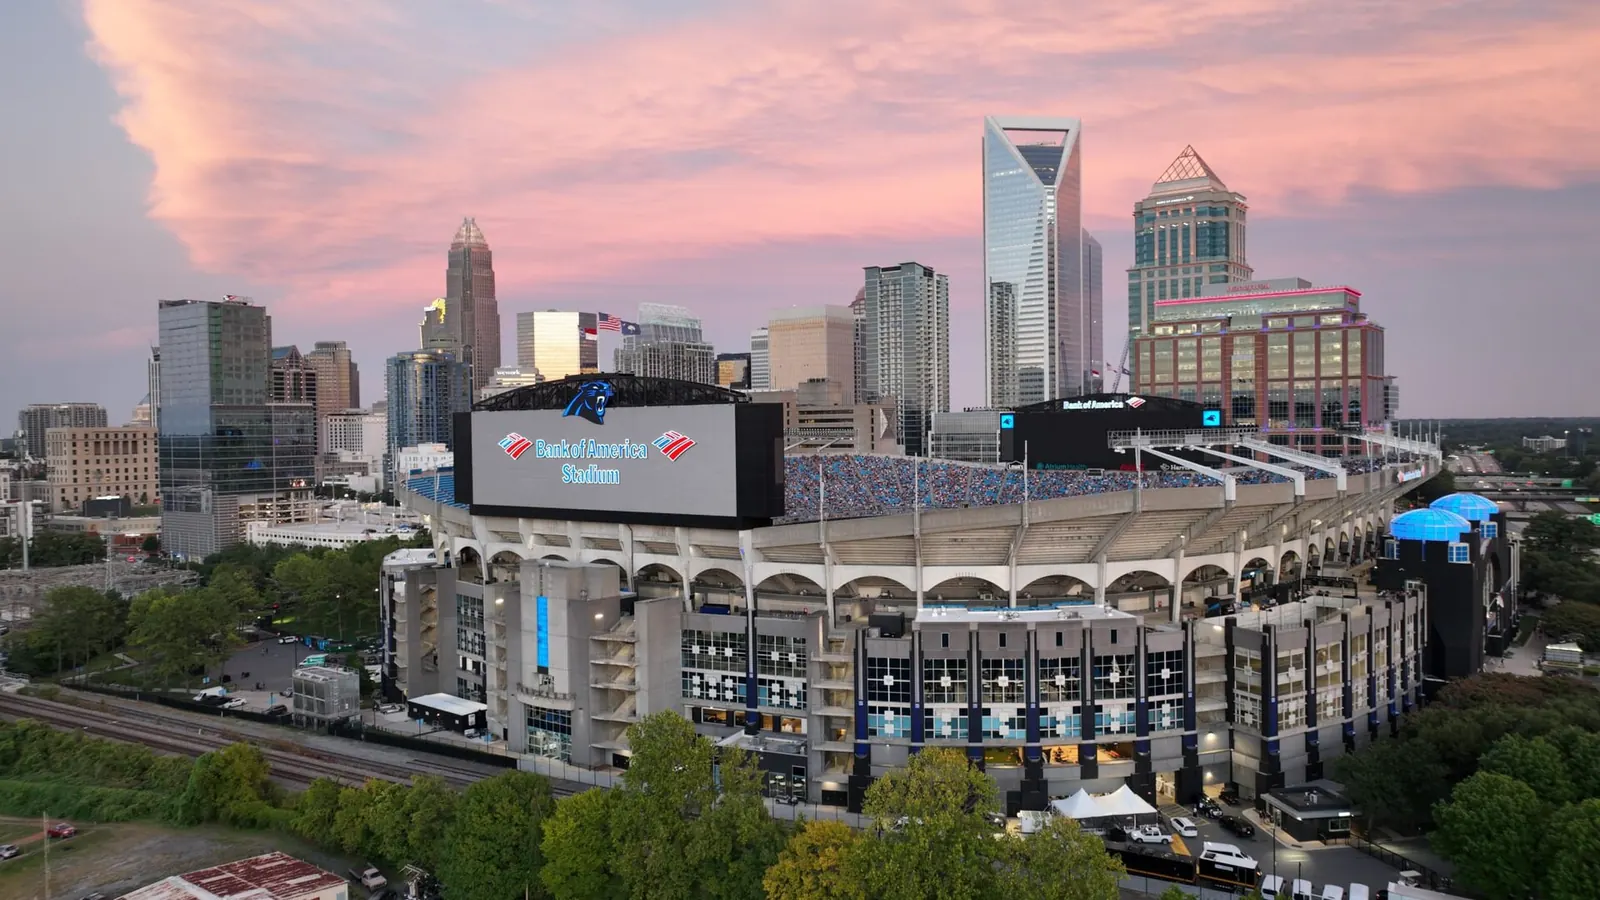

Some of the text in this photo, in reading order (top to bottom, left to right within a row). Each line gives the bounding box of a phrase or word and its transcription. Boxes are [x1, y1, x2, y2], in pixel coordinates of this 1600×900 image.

[1063, 400, 1124, 409] Bank of America
[535, 438, 648, 459] Bank of America
[562, 463, 620, 484] Stadium
